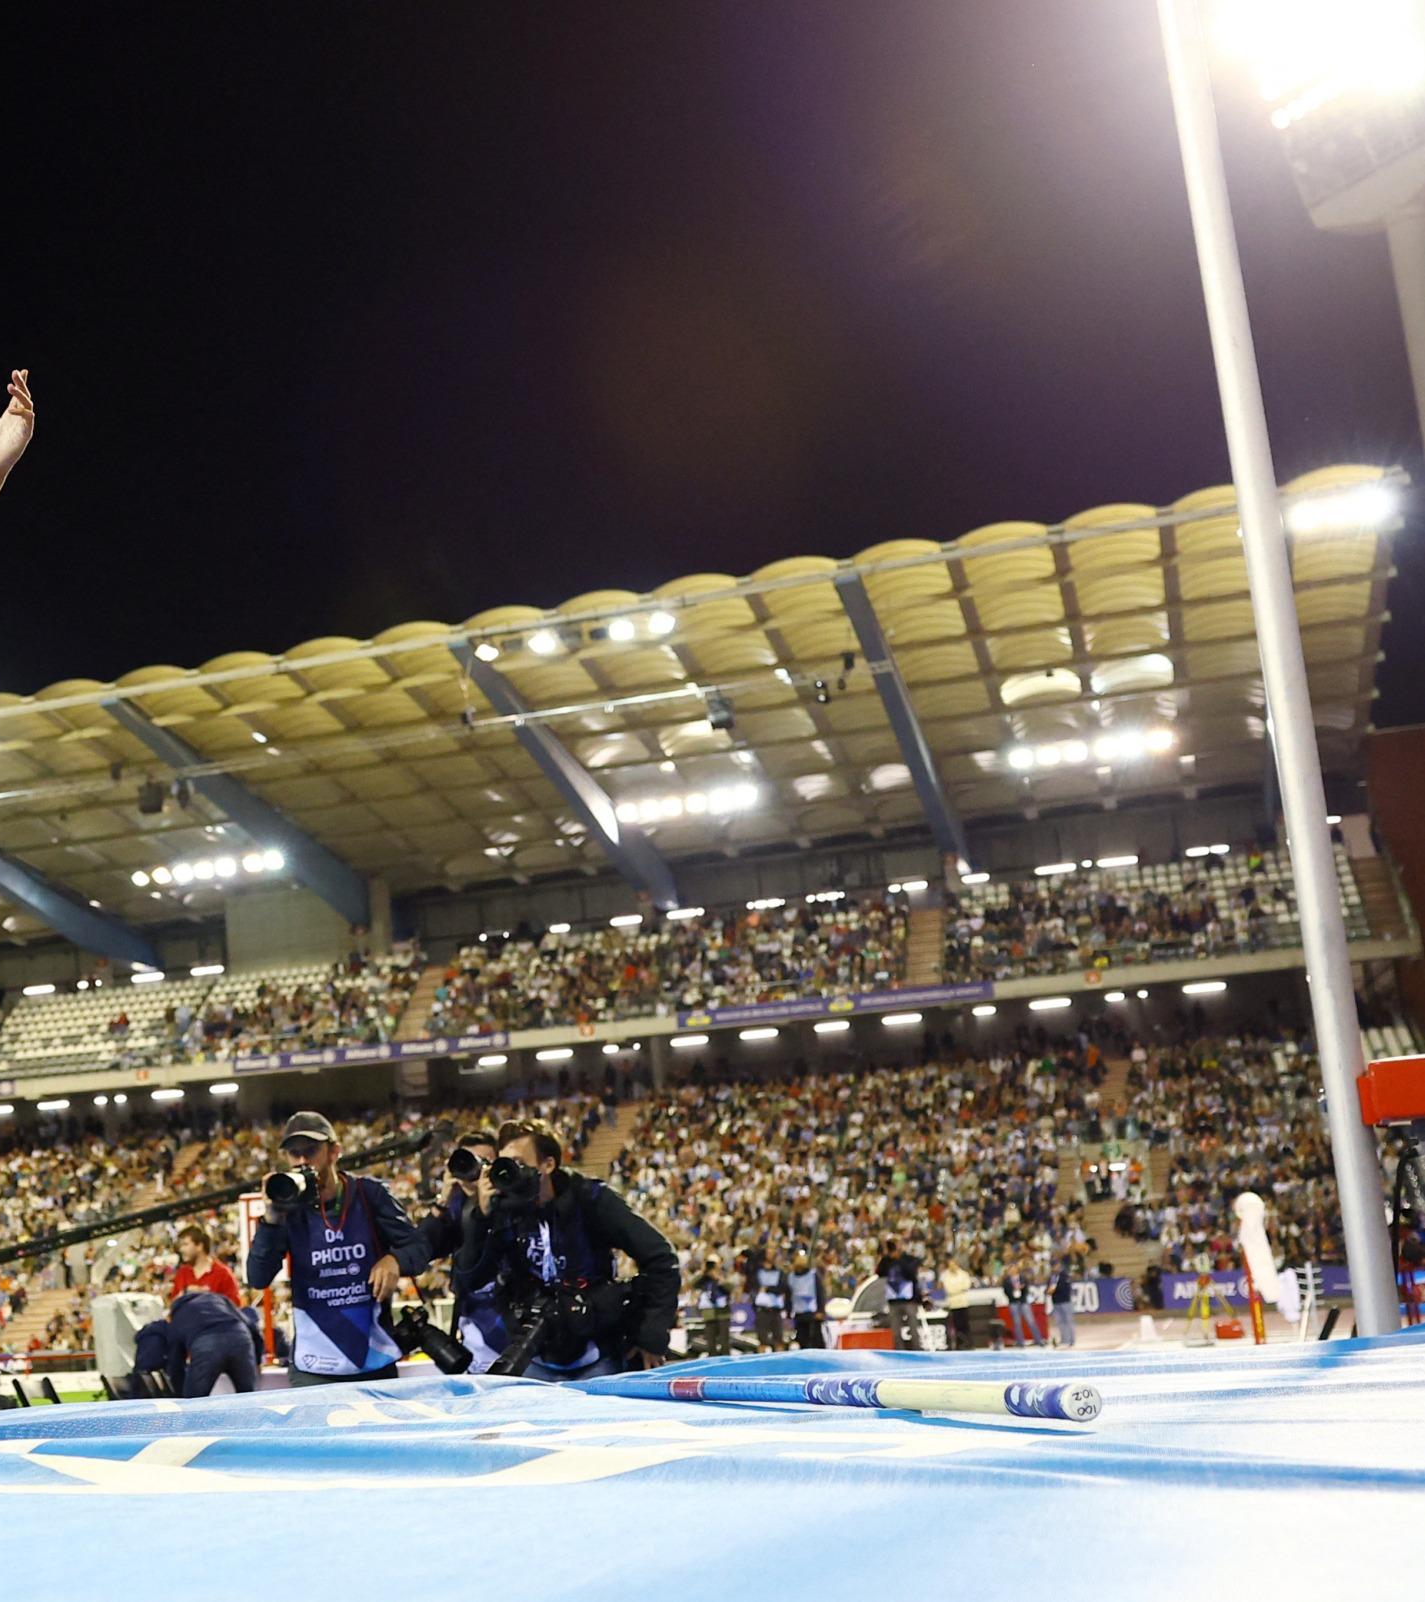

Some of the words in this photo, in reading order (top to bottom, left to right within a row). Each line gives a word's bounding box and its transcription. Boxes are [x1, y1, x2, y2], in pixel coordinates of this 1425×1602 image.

[311, 1243, 366, 1266] PHOTO
[1173, 1280, 1237, 1300] Allnz
[327, 1298, 345, 1307] van
